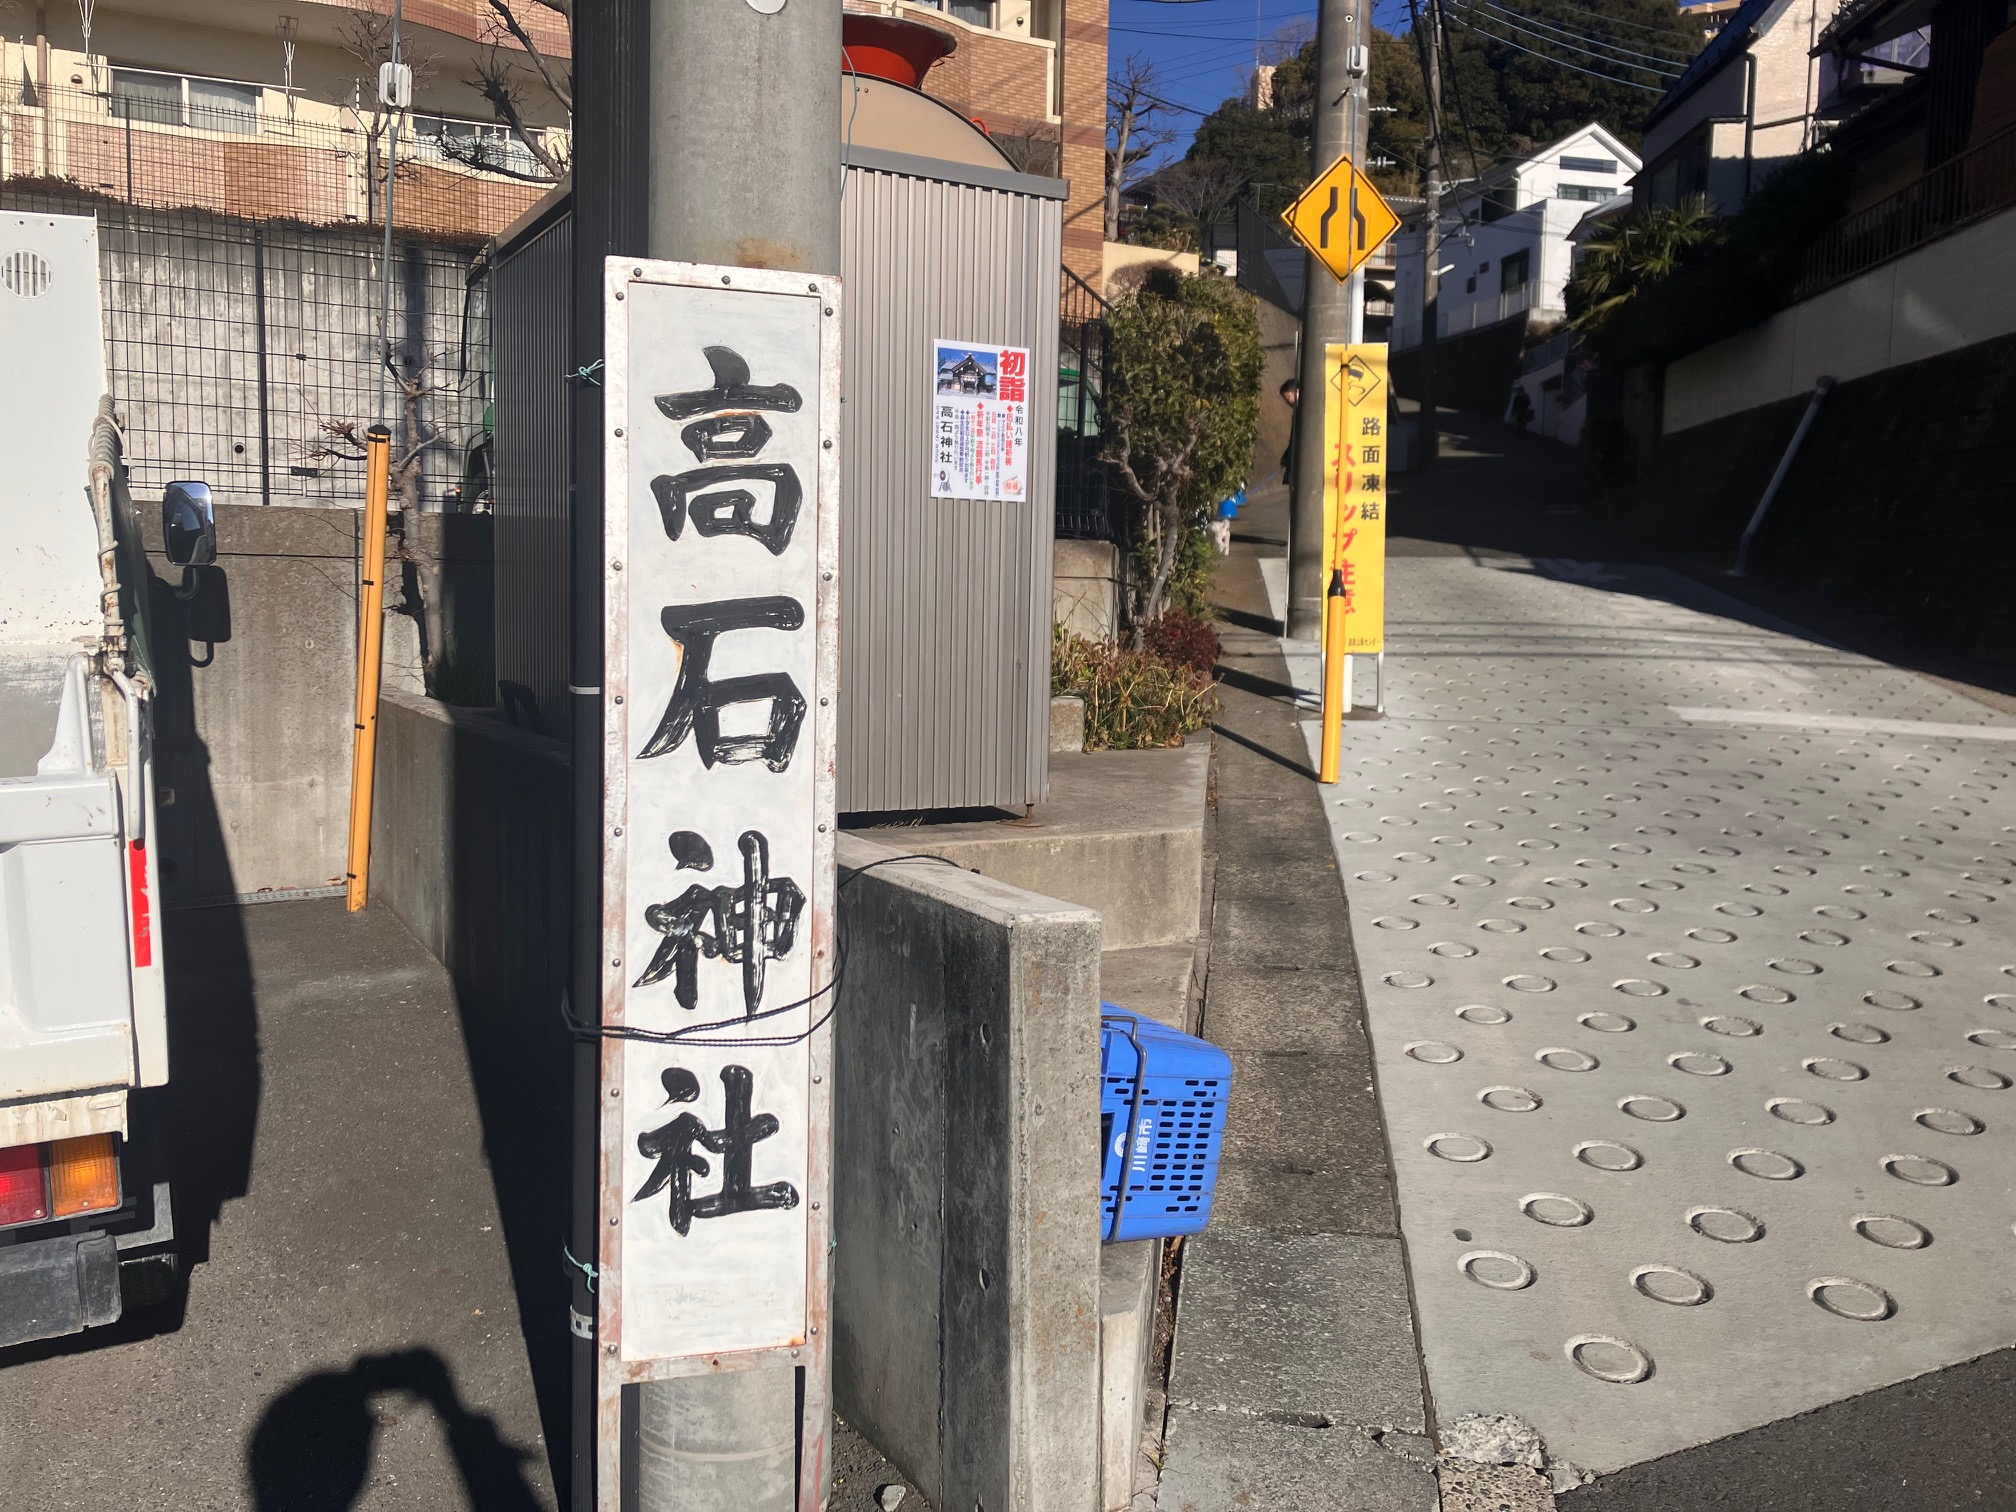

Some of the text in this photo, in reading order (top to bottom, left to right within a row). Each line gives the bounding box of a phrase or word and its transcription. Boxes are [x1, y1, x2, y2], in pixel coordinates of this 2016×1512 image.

[999, 350, 1026, 403] 初詣
[939, 405, 954, 464] 高石神社
[1014, 406, 1024, 447] 令和八年
[1361, 417, 1382, 521] 路面凍結
[630, 345, 807, 1237] 高石神社
[1131, 1118, 1153, 1172] 川崎市
